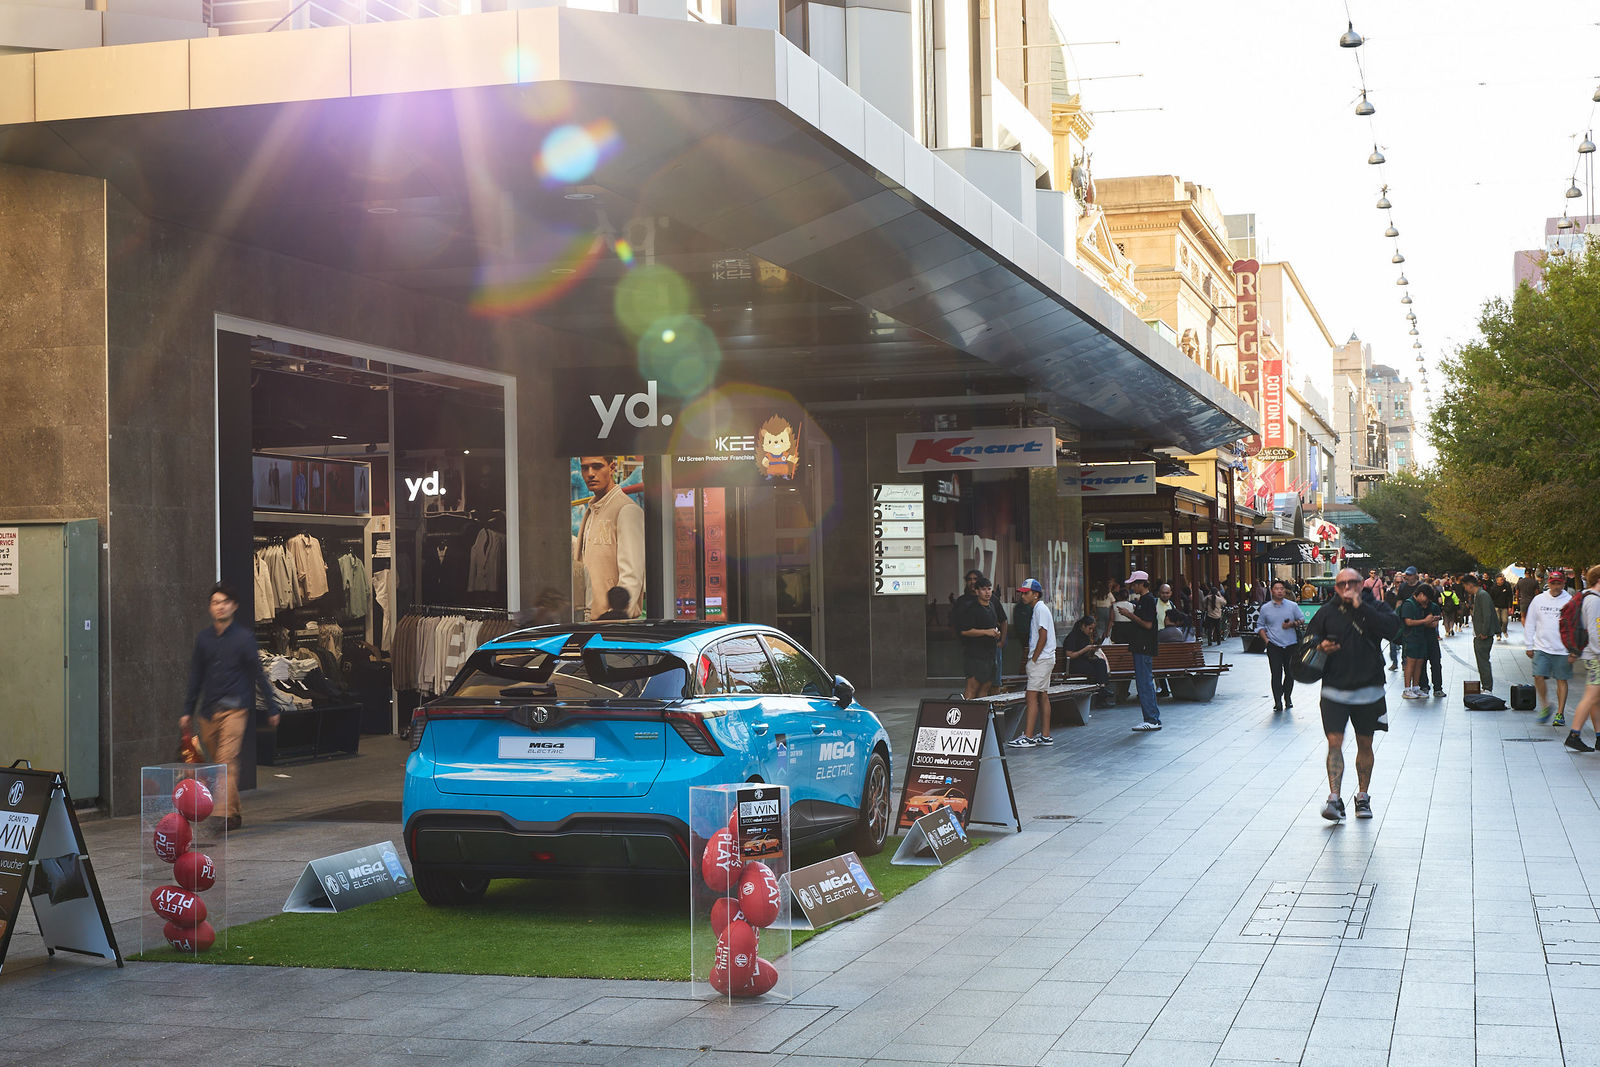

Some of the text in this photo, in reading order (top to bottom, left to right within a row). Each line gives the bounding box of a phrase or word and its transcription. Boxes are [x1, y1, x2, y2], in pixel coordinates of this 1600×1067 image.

[1237, 271, 1259, 444] REGEN
[1267, 375, 1280, 422] COTTON
[588, 380, 673, 439] yd.
[1268, 423, 1281, 440] ON
[907, 436, 1043, 465] Kmart
[405, 471, 447, 501] yd.
[874, 485, 882, 501] 7
[873, 503, 883, 519] 6
[874, 521, 883, 538] 5
[875, 541, 884, 556] 4
[875, 560, 884, 575] 3
[875, 577, 884, 594] 2
[818, 740, 856, 762] MG4
[941, 735, 978, 753] WIN
[916, 755, 974, 767] $1000 rebel voucher
[815, 763, 854, 780] ELECTRIC
[754, 804, 777, 814] WIN
[8, 814, 21, 822] SCAN
[936, 821, 955, 837] MG4
[716, 833, 732, 872] PLAY
[347, 861, 385, 880] MG4
[352, 873, 389, 889] ELECTRIC
[760, 868, 781, 909] PLAY
[819, 872, 853, 893] MG4
[156, 889, 195, 909] PLAY
[824, 885, 858, 904] ELECTRIC
